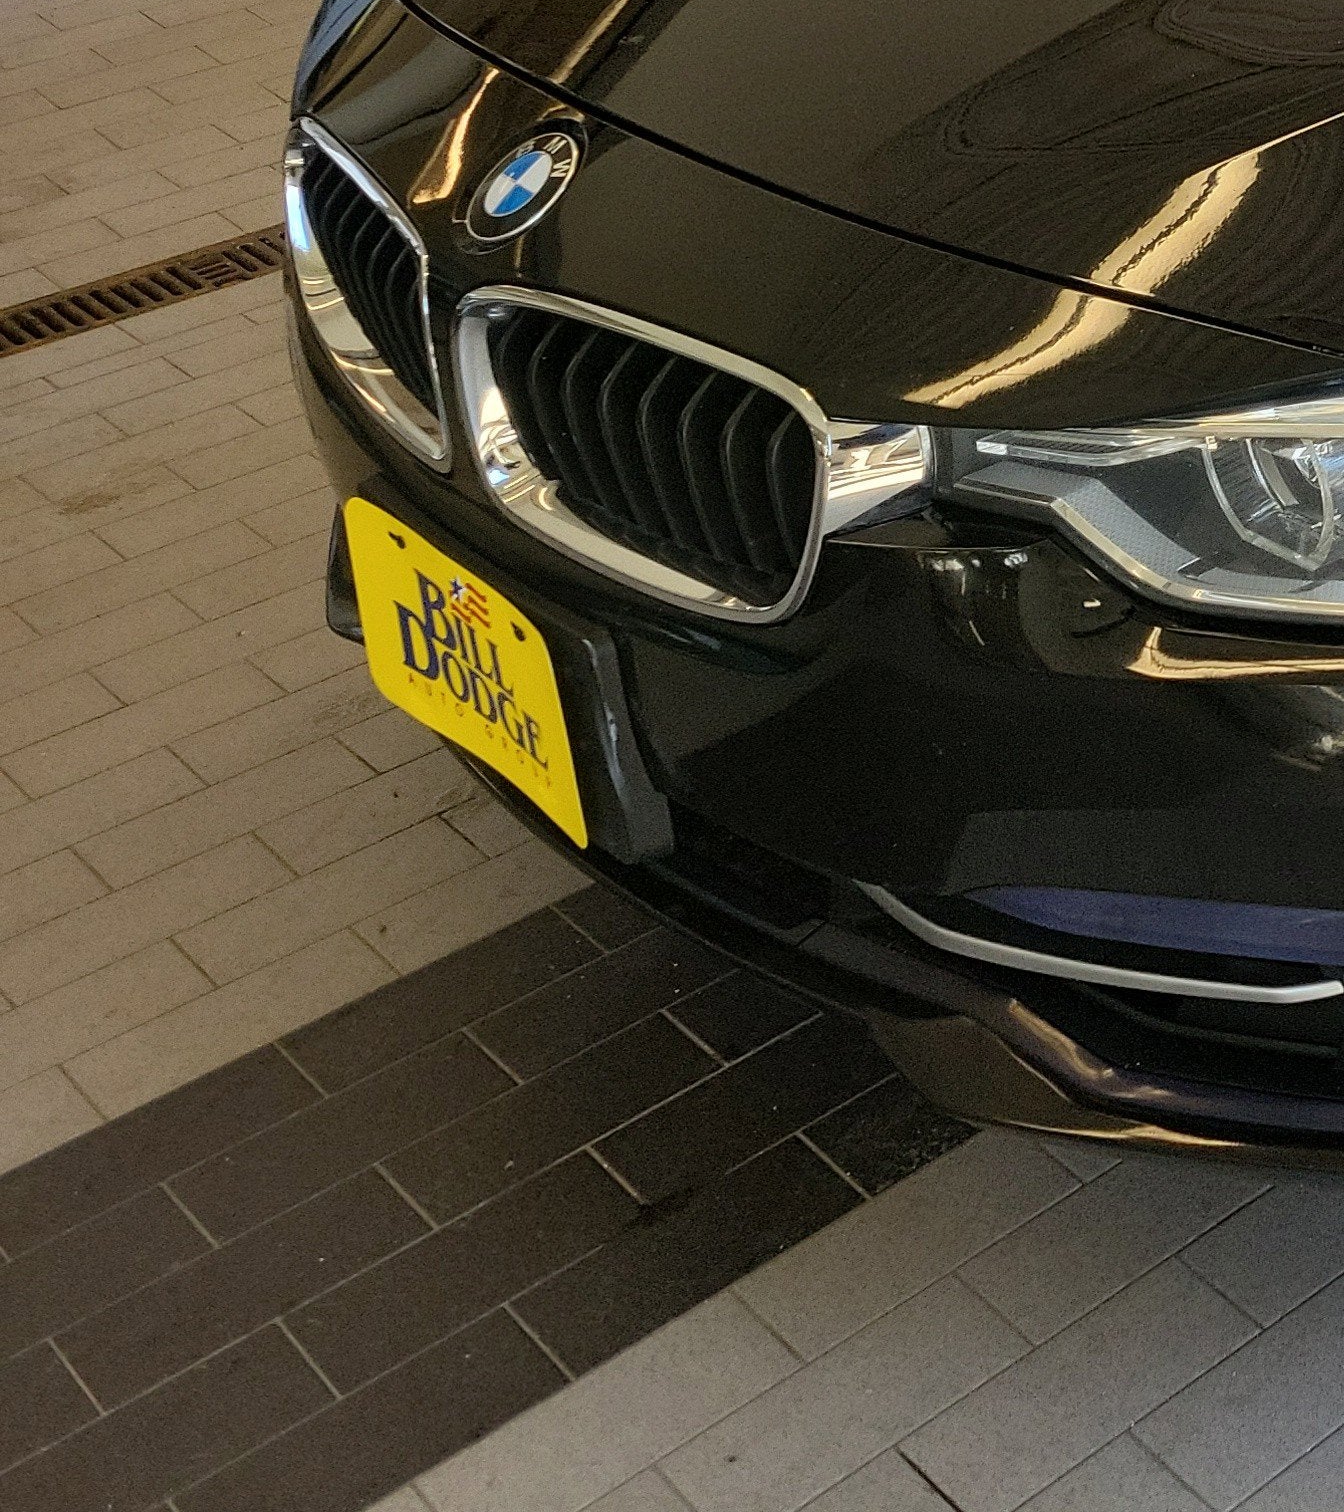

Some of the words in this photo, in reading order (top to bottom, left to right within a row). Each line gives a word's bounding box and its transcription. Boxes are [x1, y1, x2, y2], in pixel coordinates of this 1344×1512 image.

[516, 136, 572, 178] BMW
[392, 599, 550, 772] DODGE
[413, 567, 515, 699] BILL
